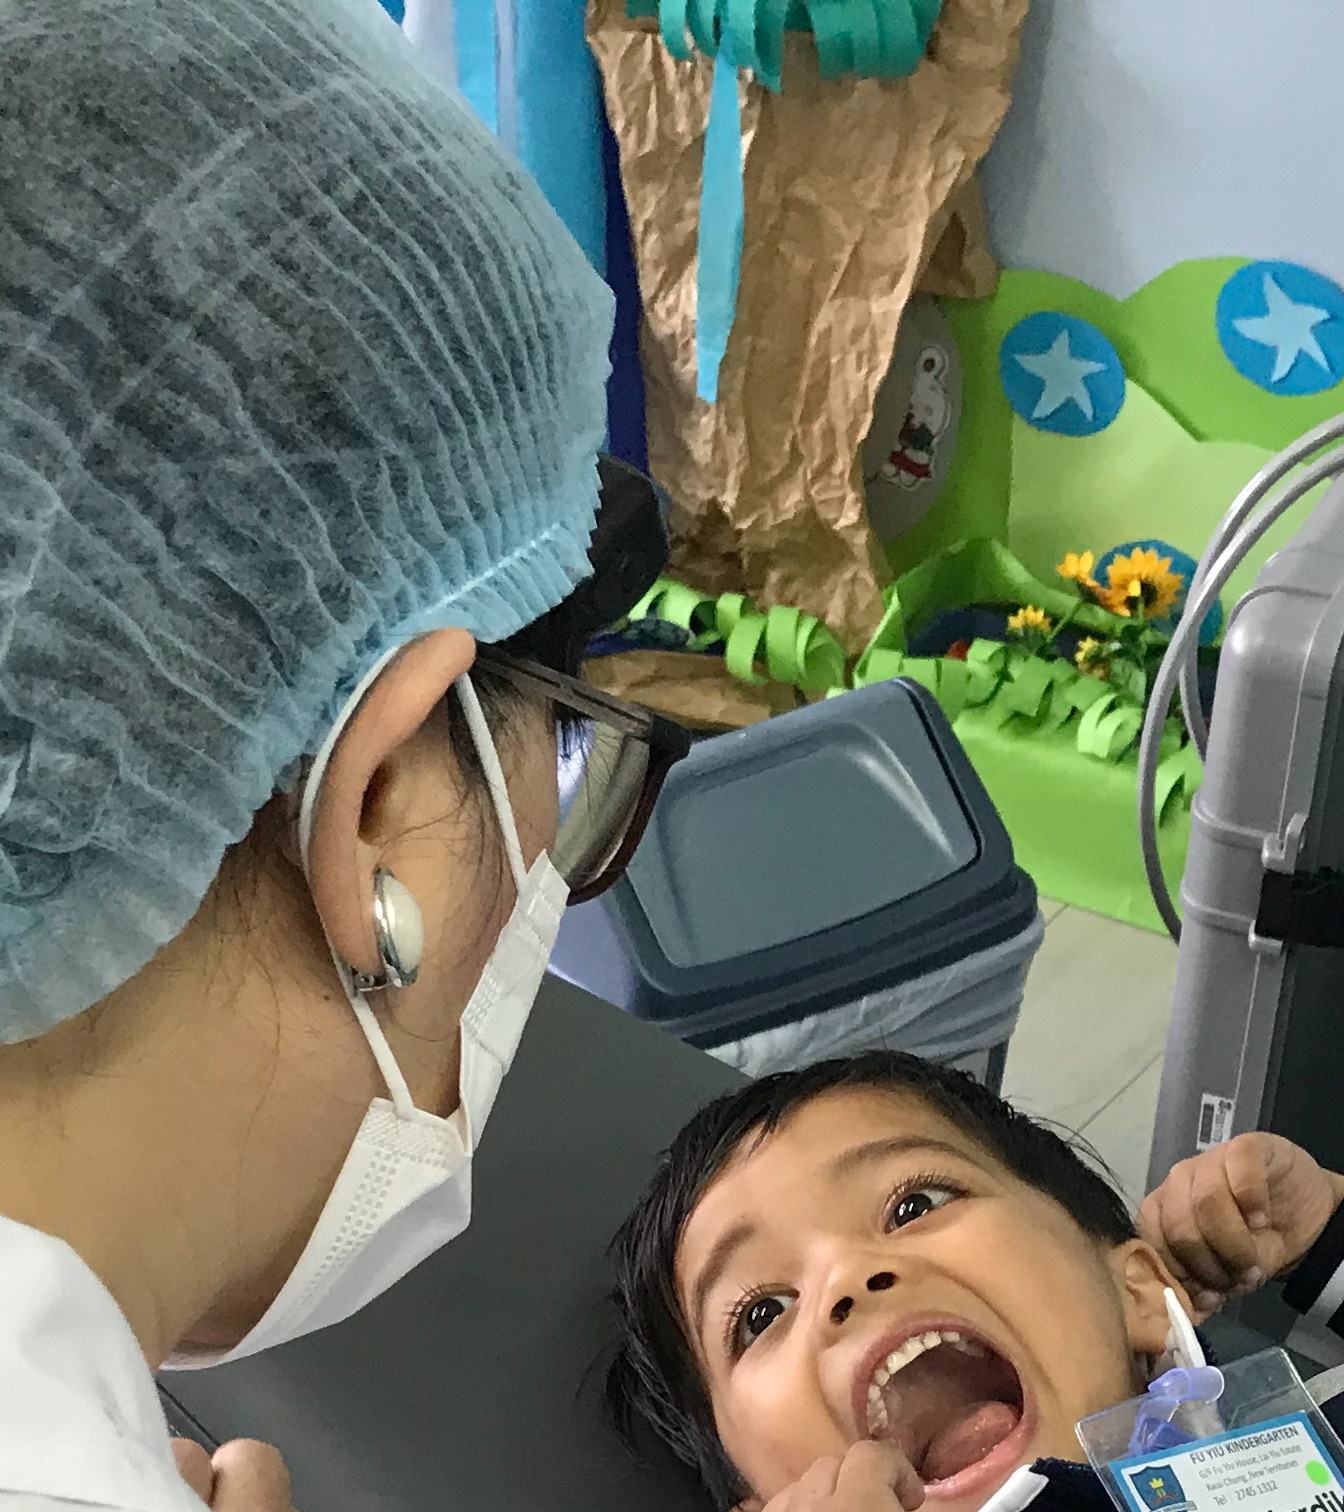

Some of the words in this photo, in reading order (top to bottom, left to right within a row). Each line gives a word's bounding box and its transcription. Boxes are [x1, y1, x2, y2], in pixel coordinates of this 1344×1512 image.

[1189, 1451, 1205, 1464] FU
[1206, 1445, 1225, 1460] YIU
[1225, 1426, 1299, 1454] KINDERGARTEN
